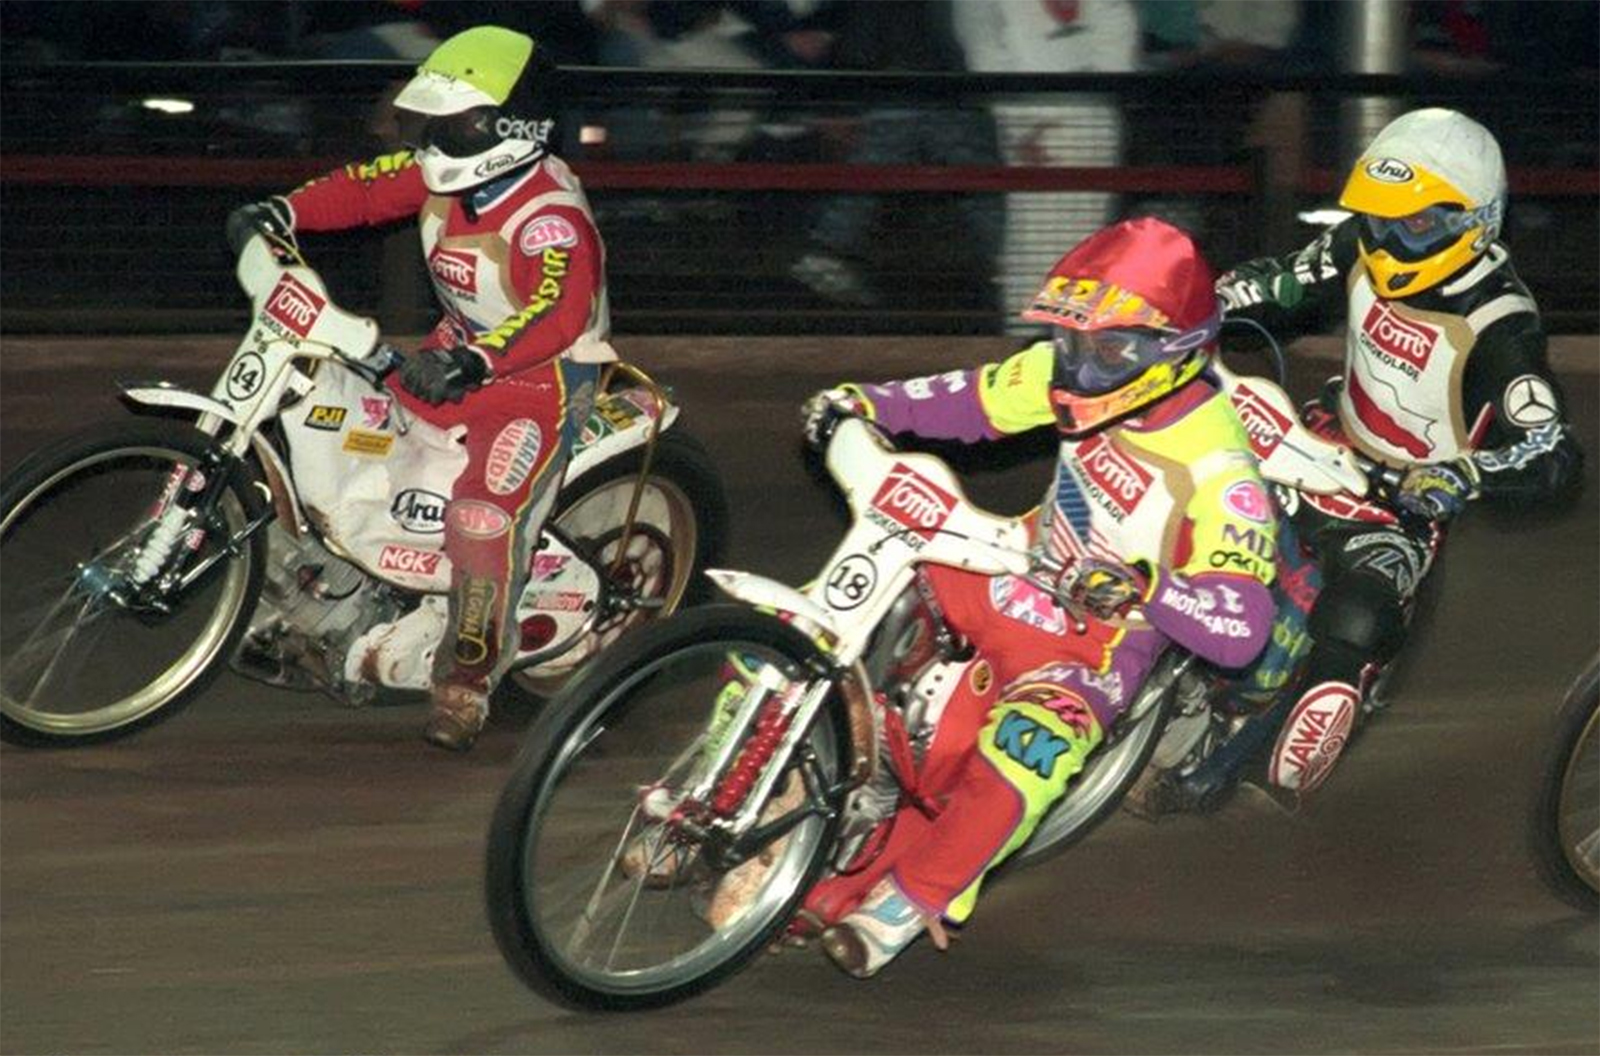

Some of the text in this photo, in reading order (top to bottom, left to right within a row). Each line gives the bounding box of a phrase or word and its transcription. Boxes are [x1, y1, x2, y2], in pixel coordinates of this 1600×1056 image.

[1373, 160, 1408, 179] Arai
[231, 362, 260, 393] 14
[381, 548, 429, 573] NGK
[828, 566, 870, 600] 18
[993, 709, 1070, 778] KK
[1284, 709, 1333, 771] JAWA
